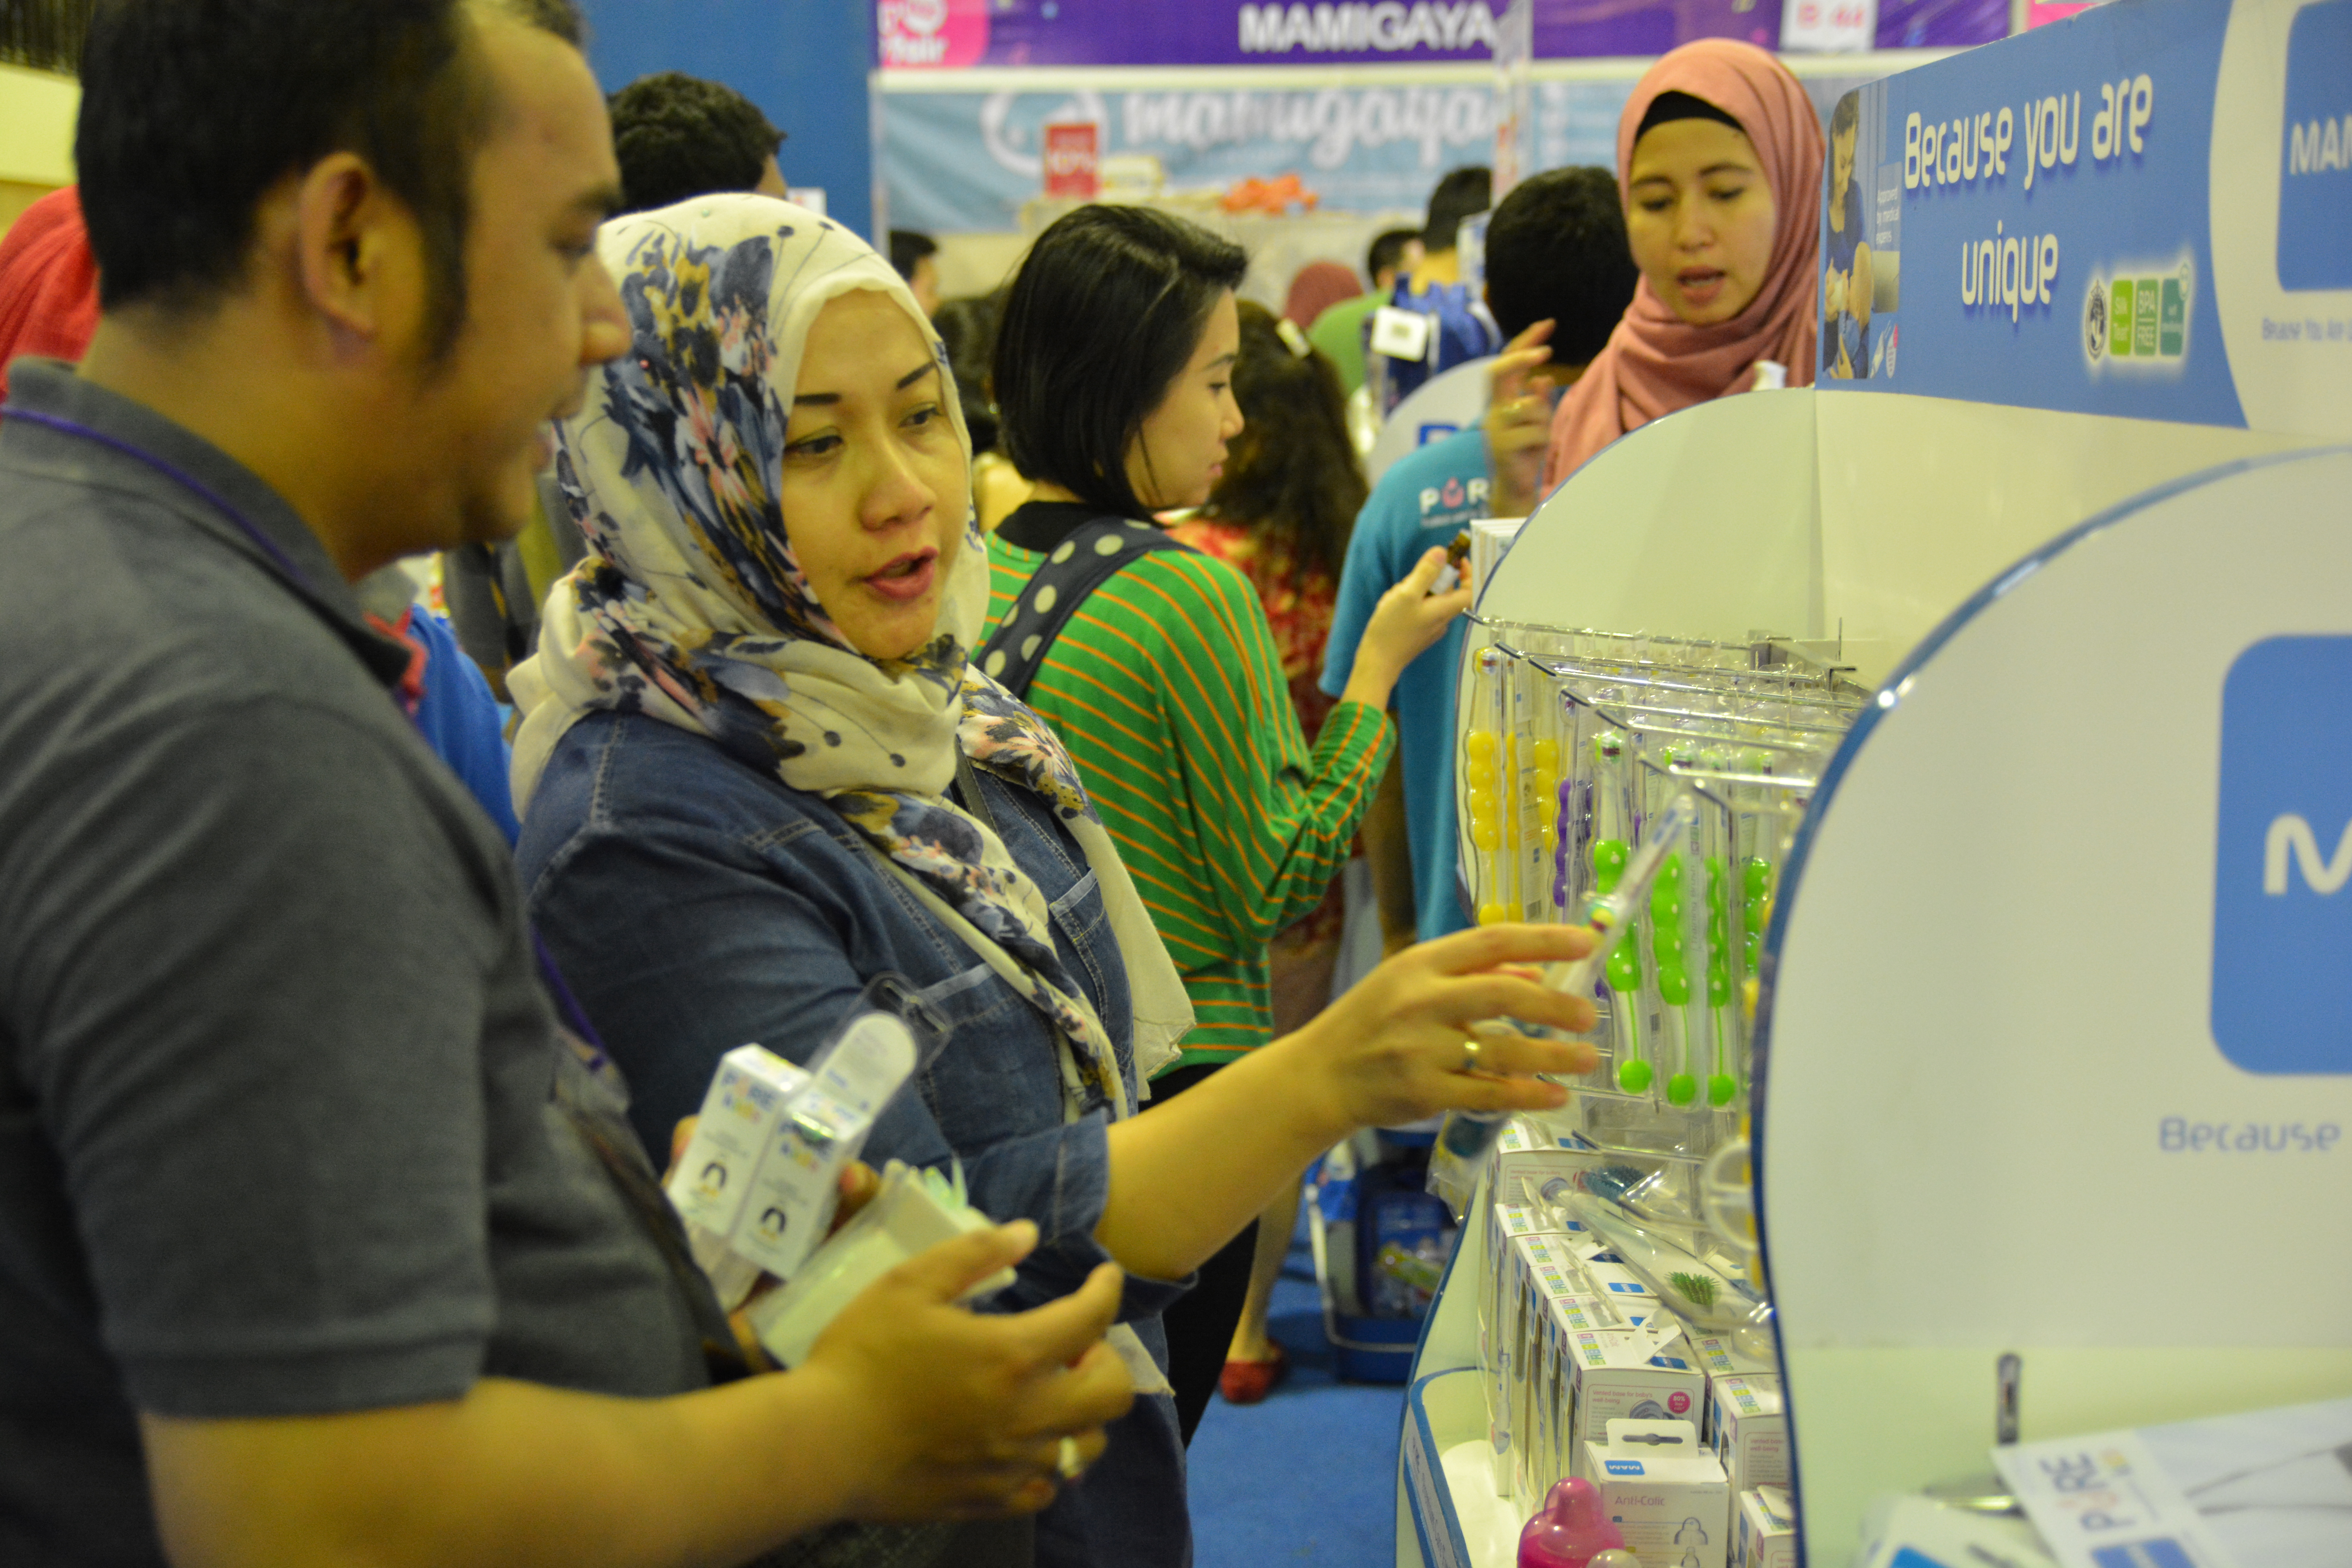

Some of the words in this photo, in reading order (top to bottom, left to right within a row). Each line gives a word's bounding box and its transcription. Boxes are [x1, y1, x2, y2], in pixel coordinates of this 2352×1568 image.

[1239, 3, 1498, 53] MAMIGAYA
[1905, 106, 2013, 189] Because
[2024, 90, 2080, 190] you
[2092, 74, 2153, 160] are
[1962, 220, 2059, 323] unique
[2158, 1116, 2342, 1152] Because
[1615, 1495, 1665, 1506] Anti-Colic
